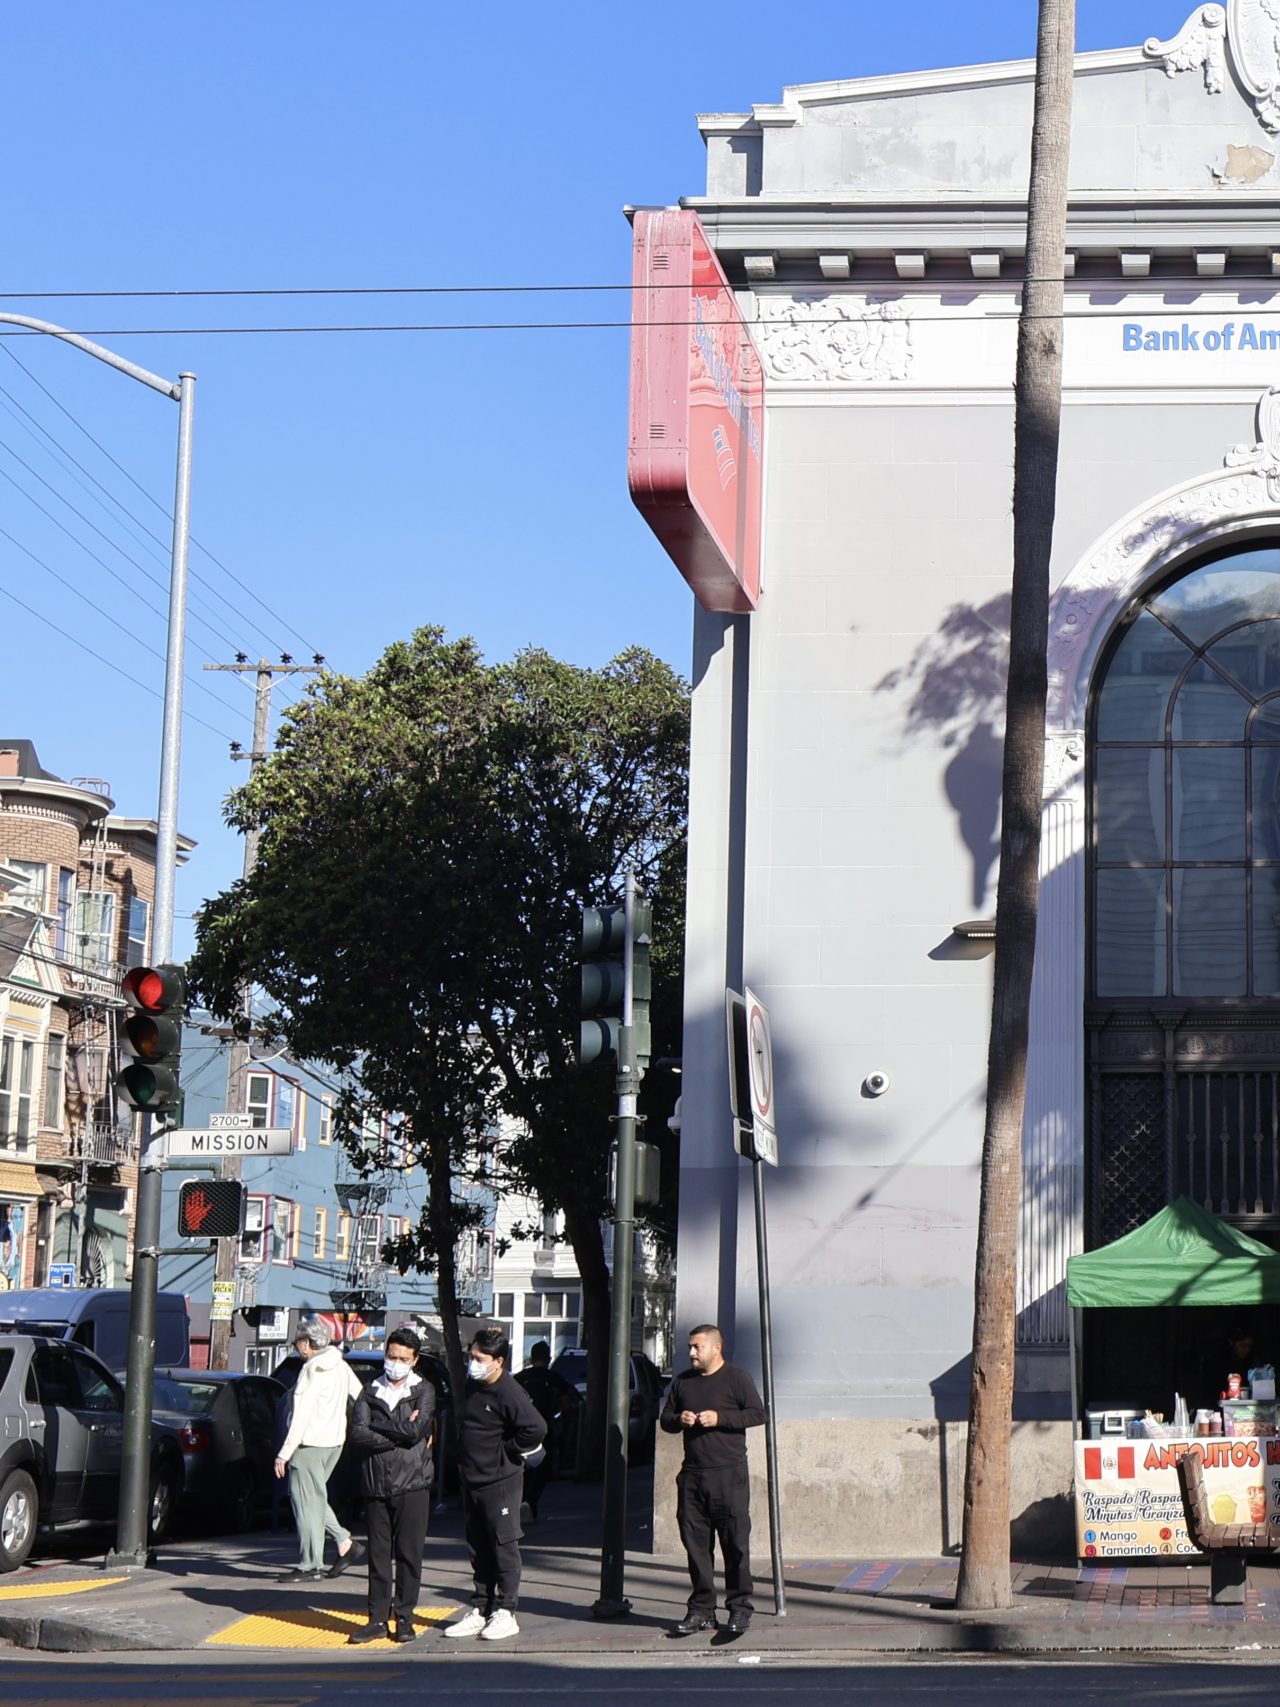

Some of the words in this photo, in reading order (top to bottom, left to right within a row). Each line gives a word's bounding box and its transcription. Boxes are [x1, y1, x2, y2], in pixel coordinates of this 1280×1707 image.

[1122, 323, 1200, 351] Bank
[1202, 322, 1235, 351] of
[211, 1116, 240, 1126] 2700
[191, 1134, 269, 1151] MISSION
[1143, 1441, 1261, 1471] ANTOJITOS
[1100, 1531, 1138, 1542] Mango
[1100, 1544, 1158, 1555] Tamarindo
